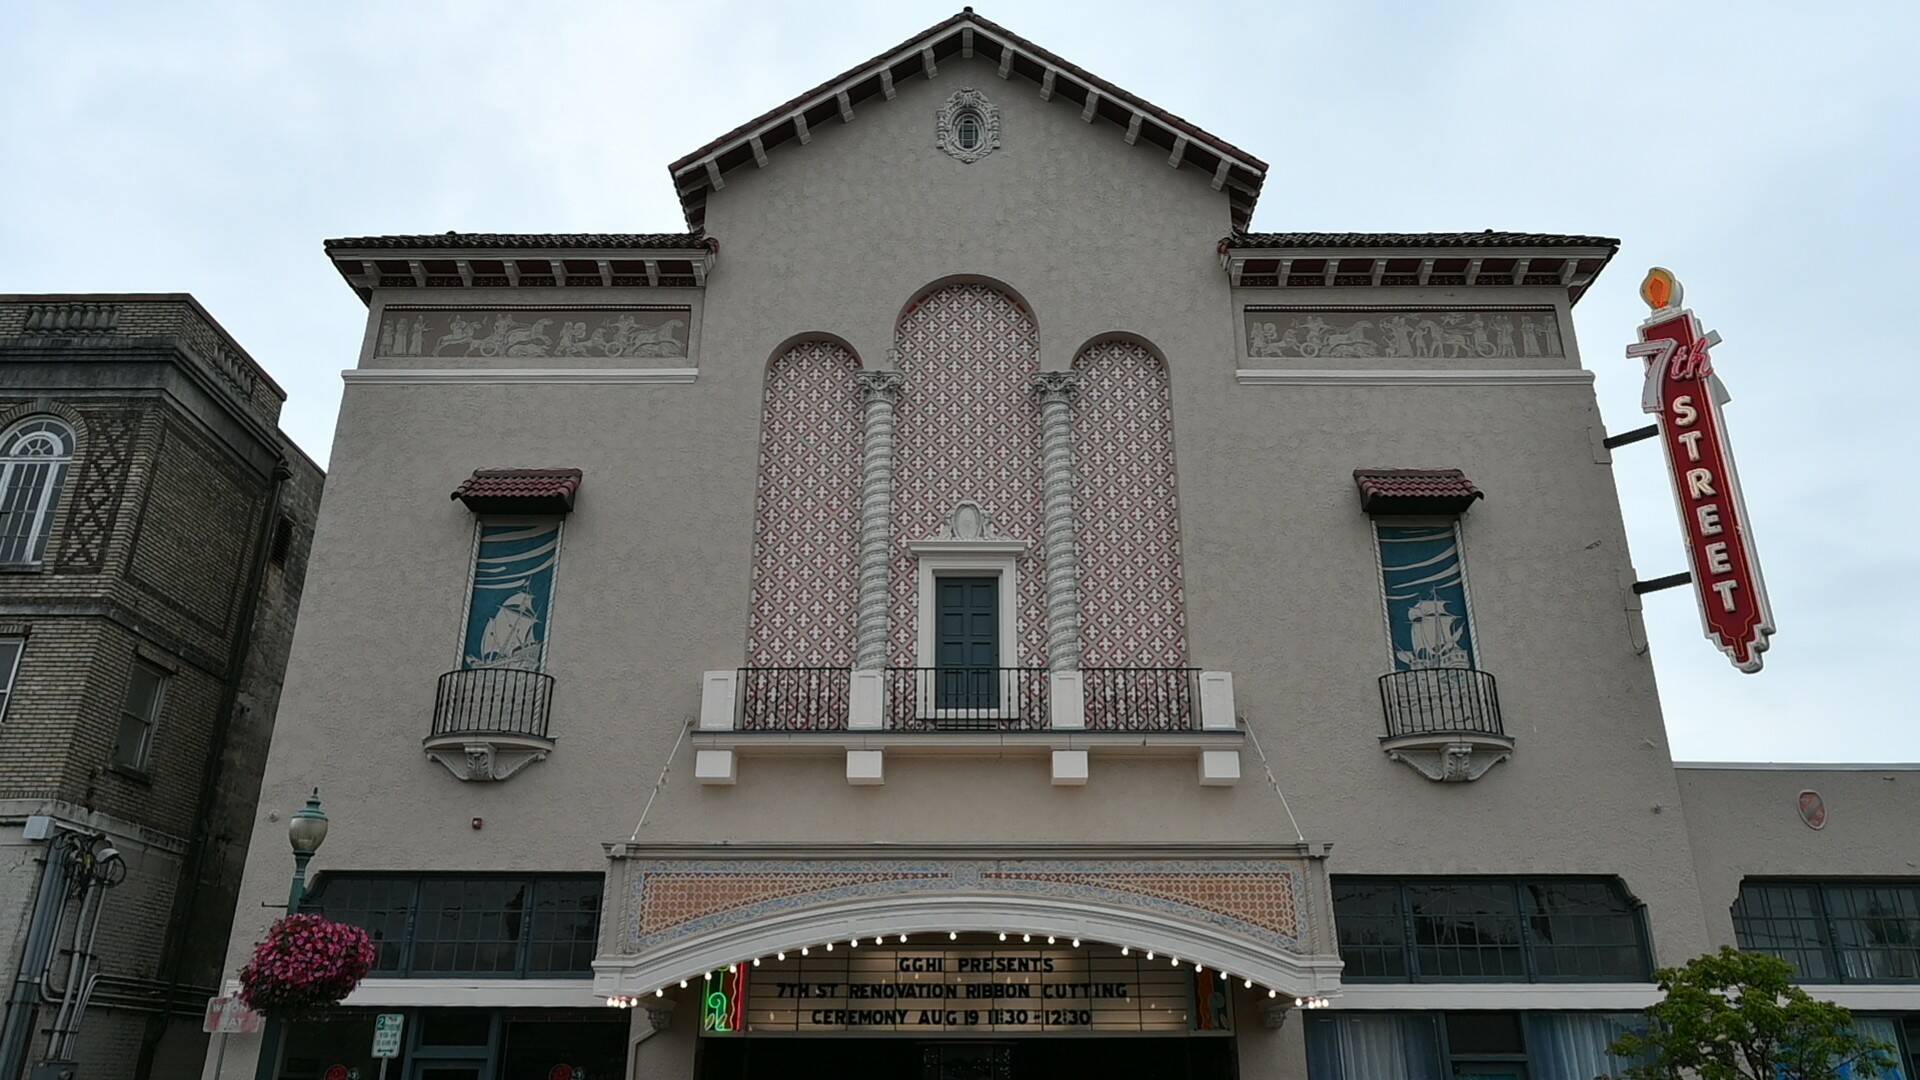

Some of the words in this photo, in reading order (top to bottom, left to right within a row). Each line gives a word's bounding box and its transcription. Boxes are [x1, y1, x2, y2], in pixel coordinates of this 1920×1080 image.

[1626, 337, 1714, 413] 7th
[1672, 395, 1739, 614] STREET
[899, 957, 944, 972] GGHI
[958, 957, 1054, 973] PRESENTS
[776, 983, 810, 998] 7TH
[817, 983, 838, 998] ST
[849, 983, 957, 998] RENOVATION
[966, 983, 1030, 998] RIBBON
[1043, 983, 1127, 998] CUTTING
[377, 1015, 386, 1030] 2
[812, 1009, 909, 1025] CEREMONY
[918, 1009, 957, 1025] AUG
[964, 1009, 979, 1025] 19
[988, 1009, 1028, 1025] 11:30
[1045, 1009, 1091, 1025] 12:30
